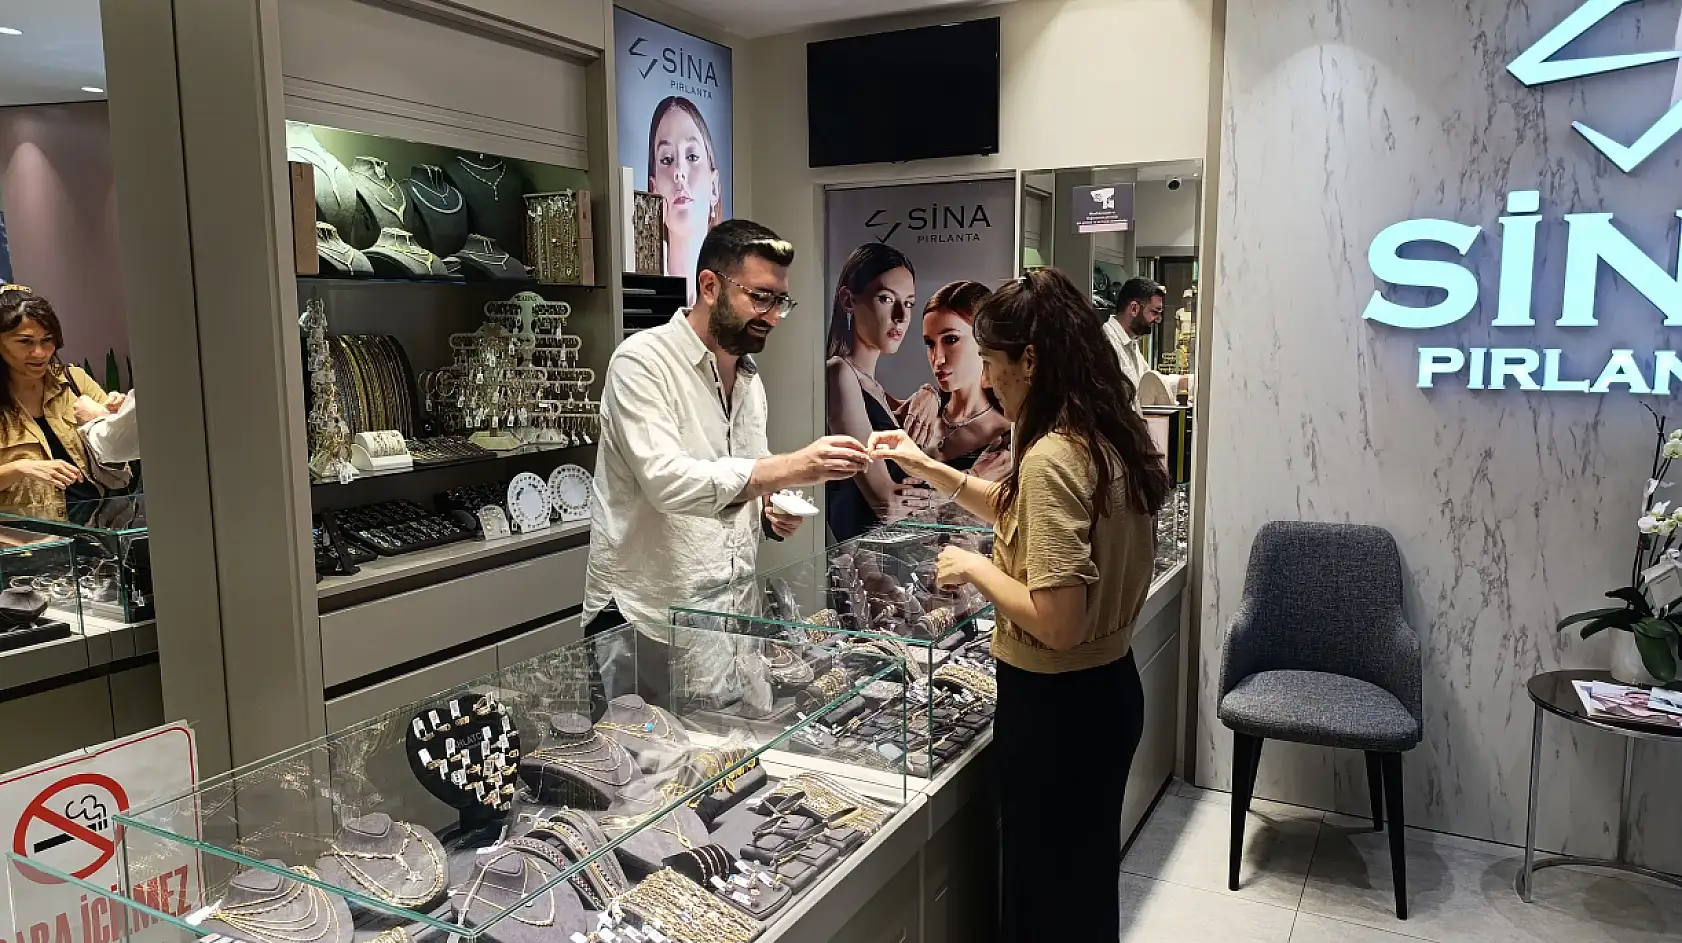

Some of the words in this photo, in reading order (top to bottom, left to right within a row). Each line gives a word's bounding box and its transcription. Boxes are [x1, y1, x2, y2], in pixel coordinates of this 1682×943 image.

[662, 47, 719, 88] SİNA
[670, 79, 713, 101] PIRLANTA
[907, 203, 992, 231] SİNA
[917, 233, 981, 244] PIRLANTA
